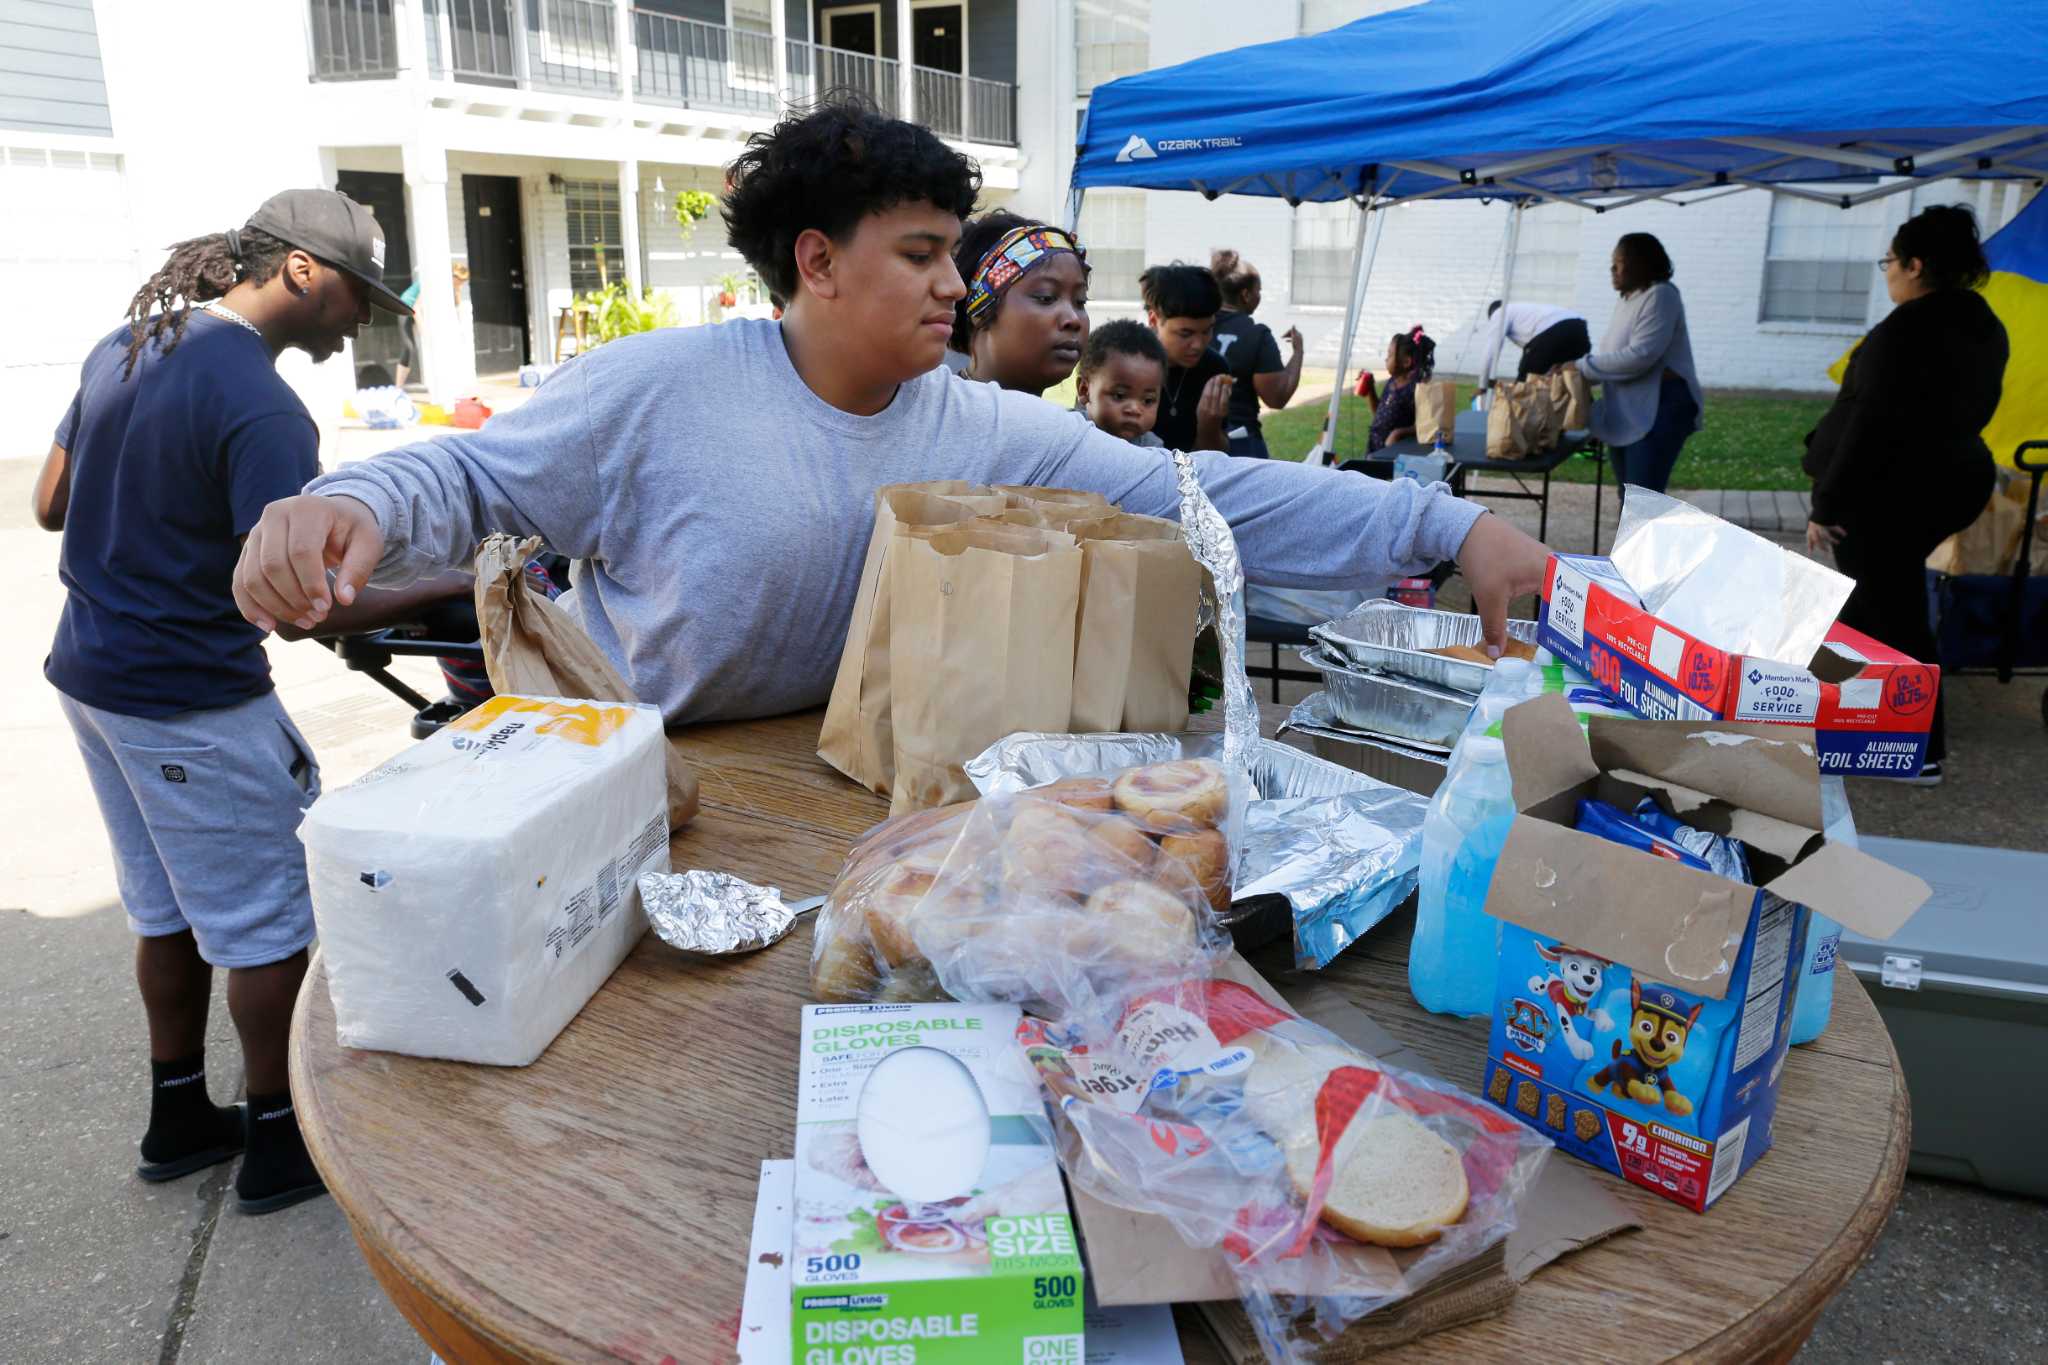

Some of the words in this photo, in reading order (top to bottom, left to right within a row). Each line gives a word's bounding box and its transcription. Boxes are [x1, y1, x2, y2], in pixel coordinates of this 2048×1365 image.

[1561, 596, 1575, 613] FOOD
[1555, 610, 1577, 633] SERVICE
[1627, 635, 1648, 652] PRE-CUT
[1590, 642, 1621, 694] 500
[1764, 674, 1794, 682] Member's
[1795, 676, 1811, 684] Mark
[1620, 678, 1639, 709] FOIL
[1644, 679, 1677, 712] ALUMINUM
[1765, 685, 1795, 698] FOOD
[1753, 702, 1803, 713] SERVICE
[1866, 741, 1919, 753] ALUMINUM
[1820, 752, 1852, 768] FOIL
[1856, 753, 1914, 770] SHEETS
[812, 1017, 983, 1041] DISPOSABLE
[811, 1034, 921, 1055] GLOVES
[1622, 1122, 1648, 1152] 9g
[1652, 1124, 1707, 1153] CINNAMON
[991, 1216, 1069, 1237] ONE
[992, 1235, 1075, 1257] SIZE
[807, 1253, 861, 1273] 500
[805, 1271, 860, 1282] GLOVES
[1033, 1275, 1076, 1298] 500
[1033, 1298, 1075, 1310] GLOVES
[805, 1314, 979, 1344] DISPOSABLE
[805, 1343, 917, 1365] GLOVES
[1028, 1338, 1078, 1358] ONE
